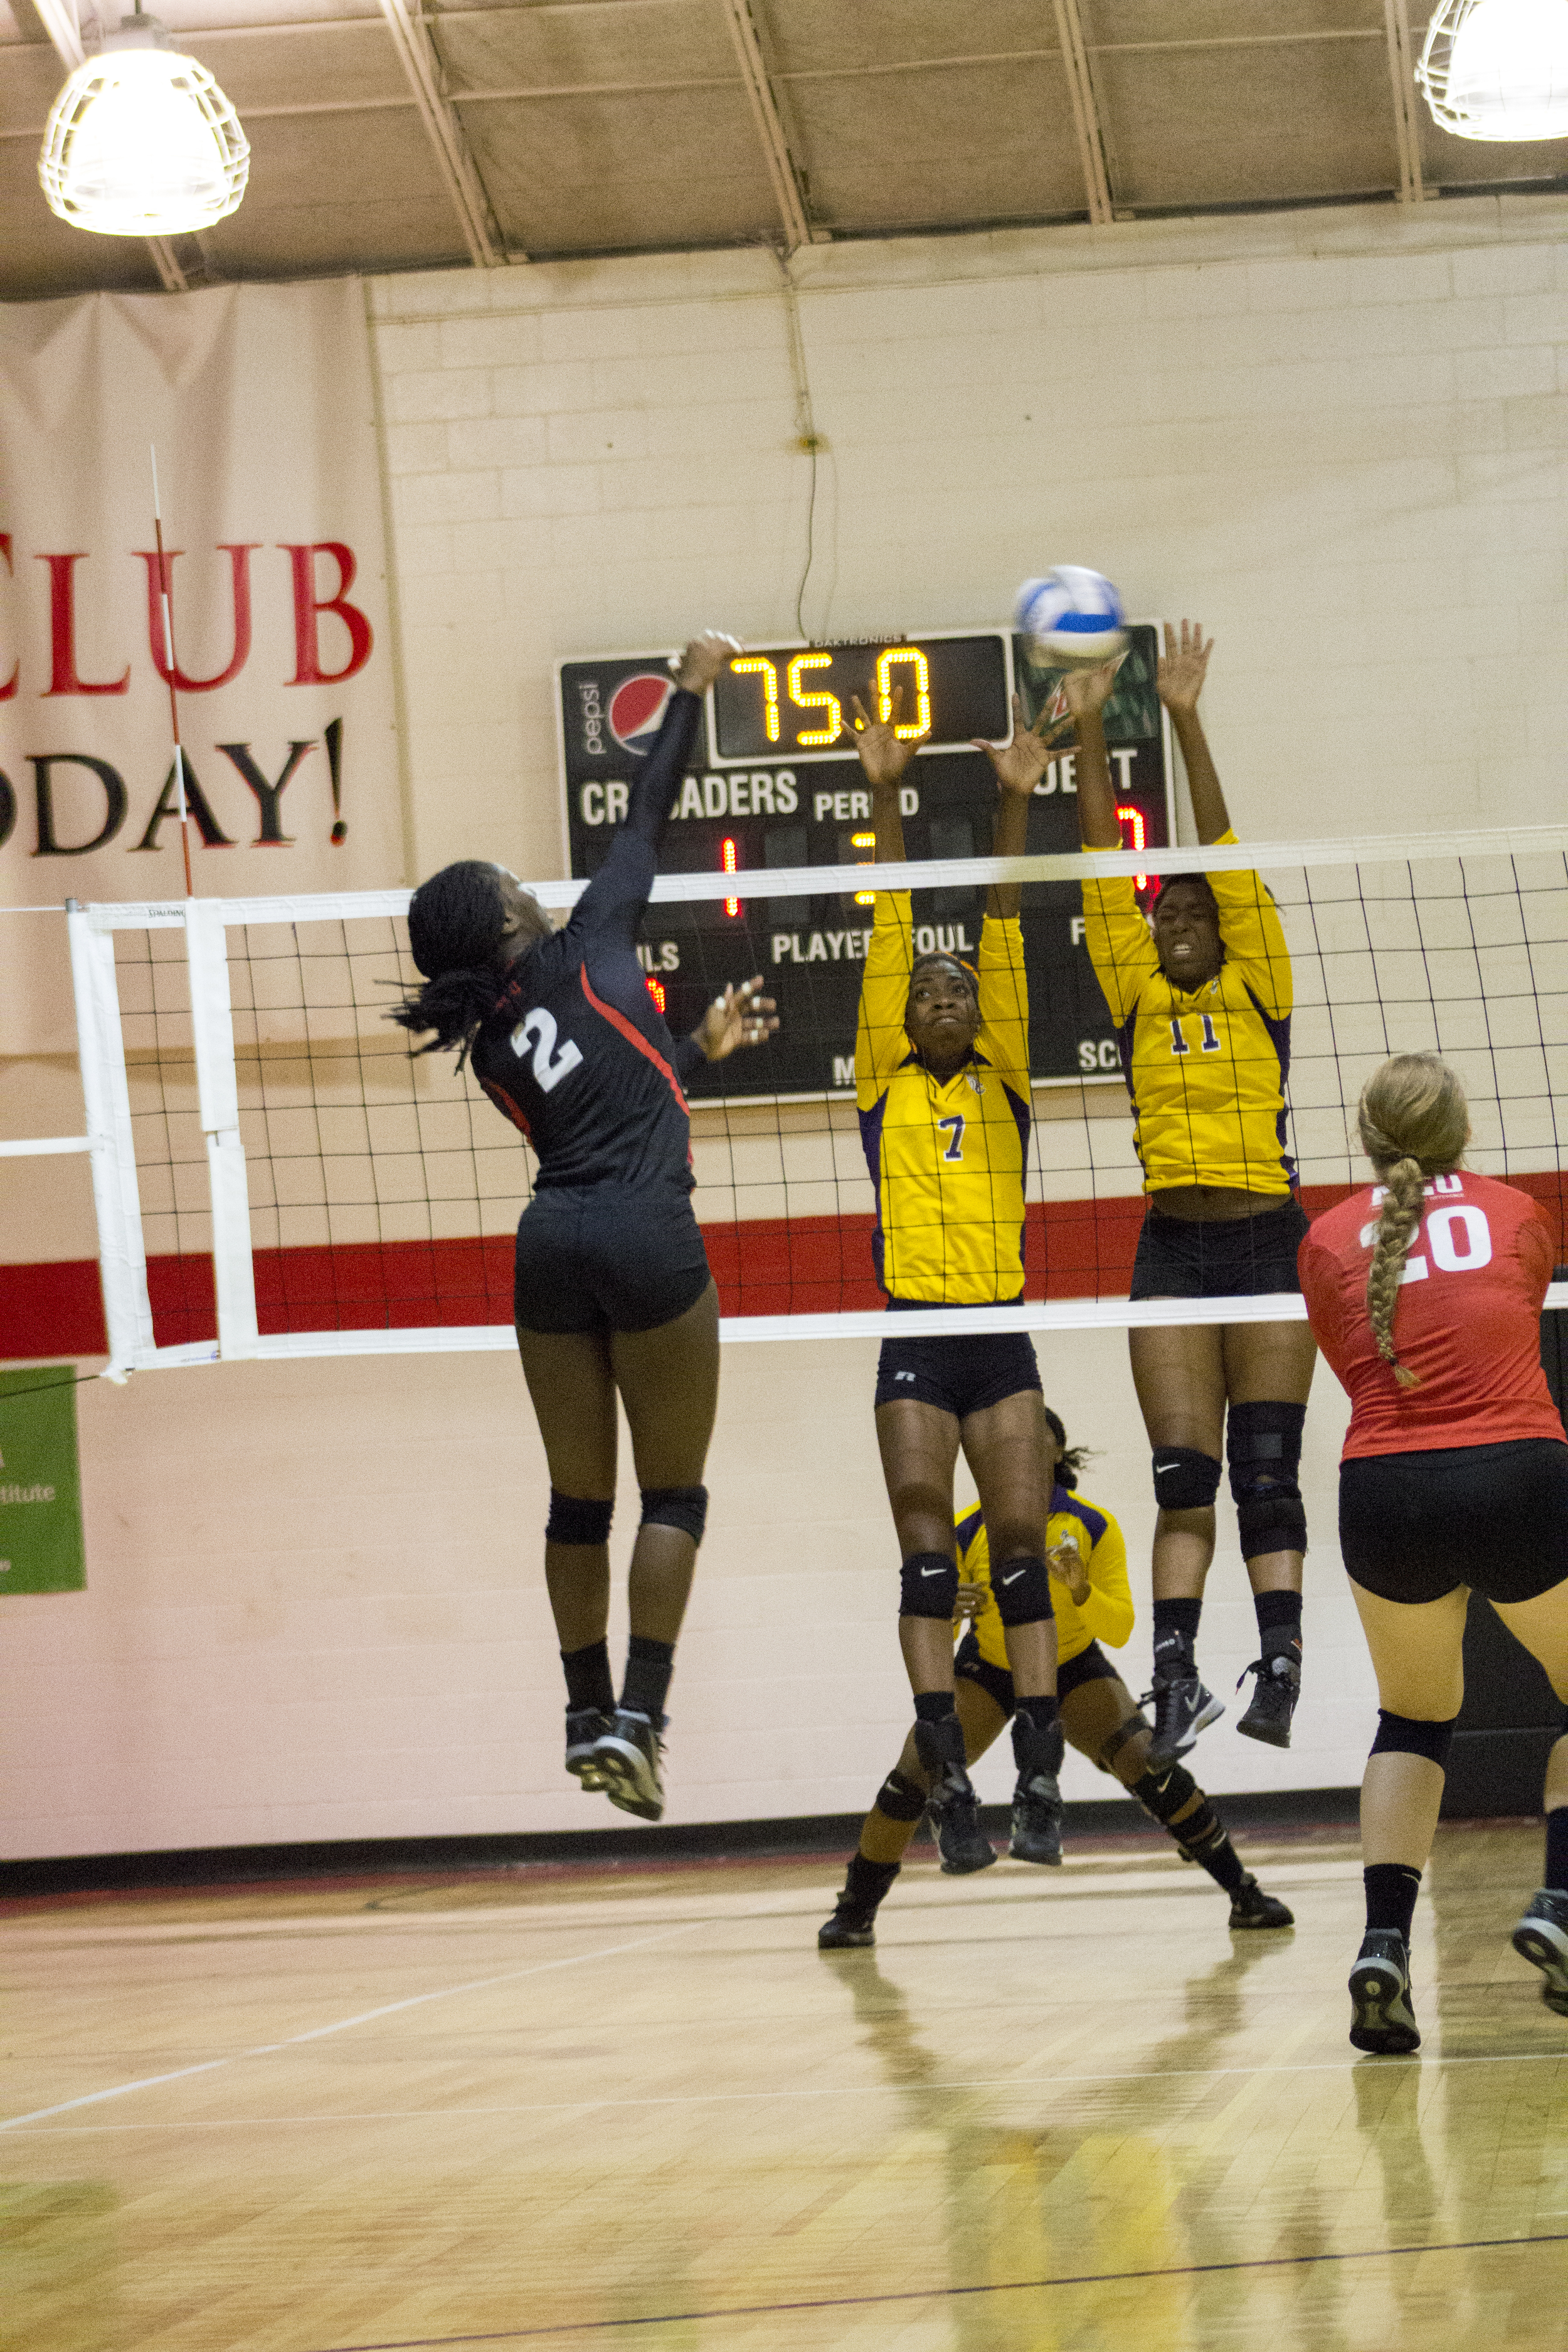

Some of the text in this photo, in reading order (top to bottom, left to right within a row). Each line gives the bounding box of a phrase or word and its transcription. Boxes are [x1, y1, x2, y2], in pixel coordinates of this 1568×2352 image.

[0, 534, 374, 702] LUB
[579, 684, 607, 755] pepsi
[0, 716, 348, 858] DAY!
[582, 770, 798, 825] CRADERS
[815, 788, 919, 821] PERD
[910, 924, 973, 955] OUL
[510, 1007, 583, 1093] 2
[1170, 1014, 1221, 1055] 11
[937, 1113, 966, 1162] 7
